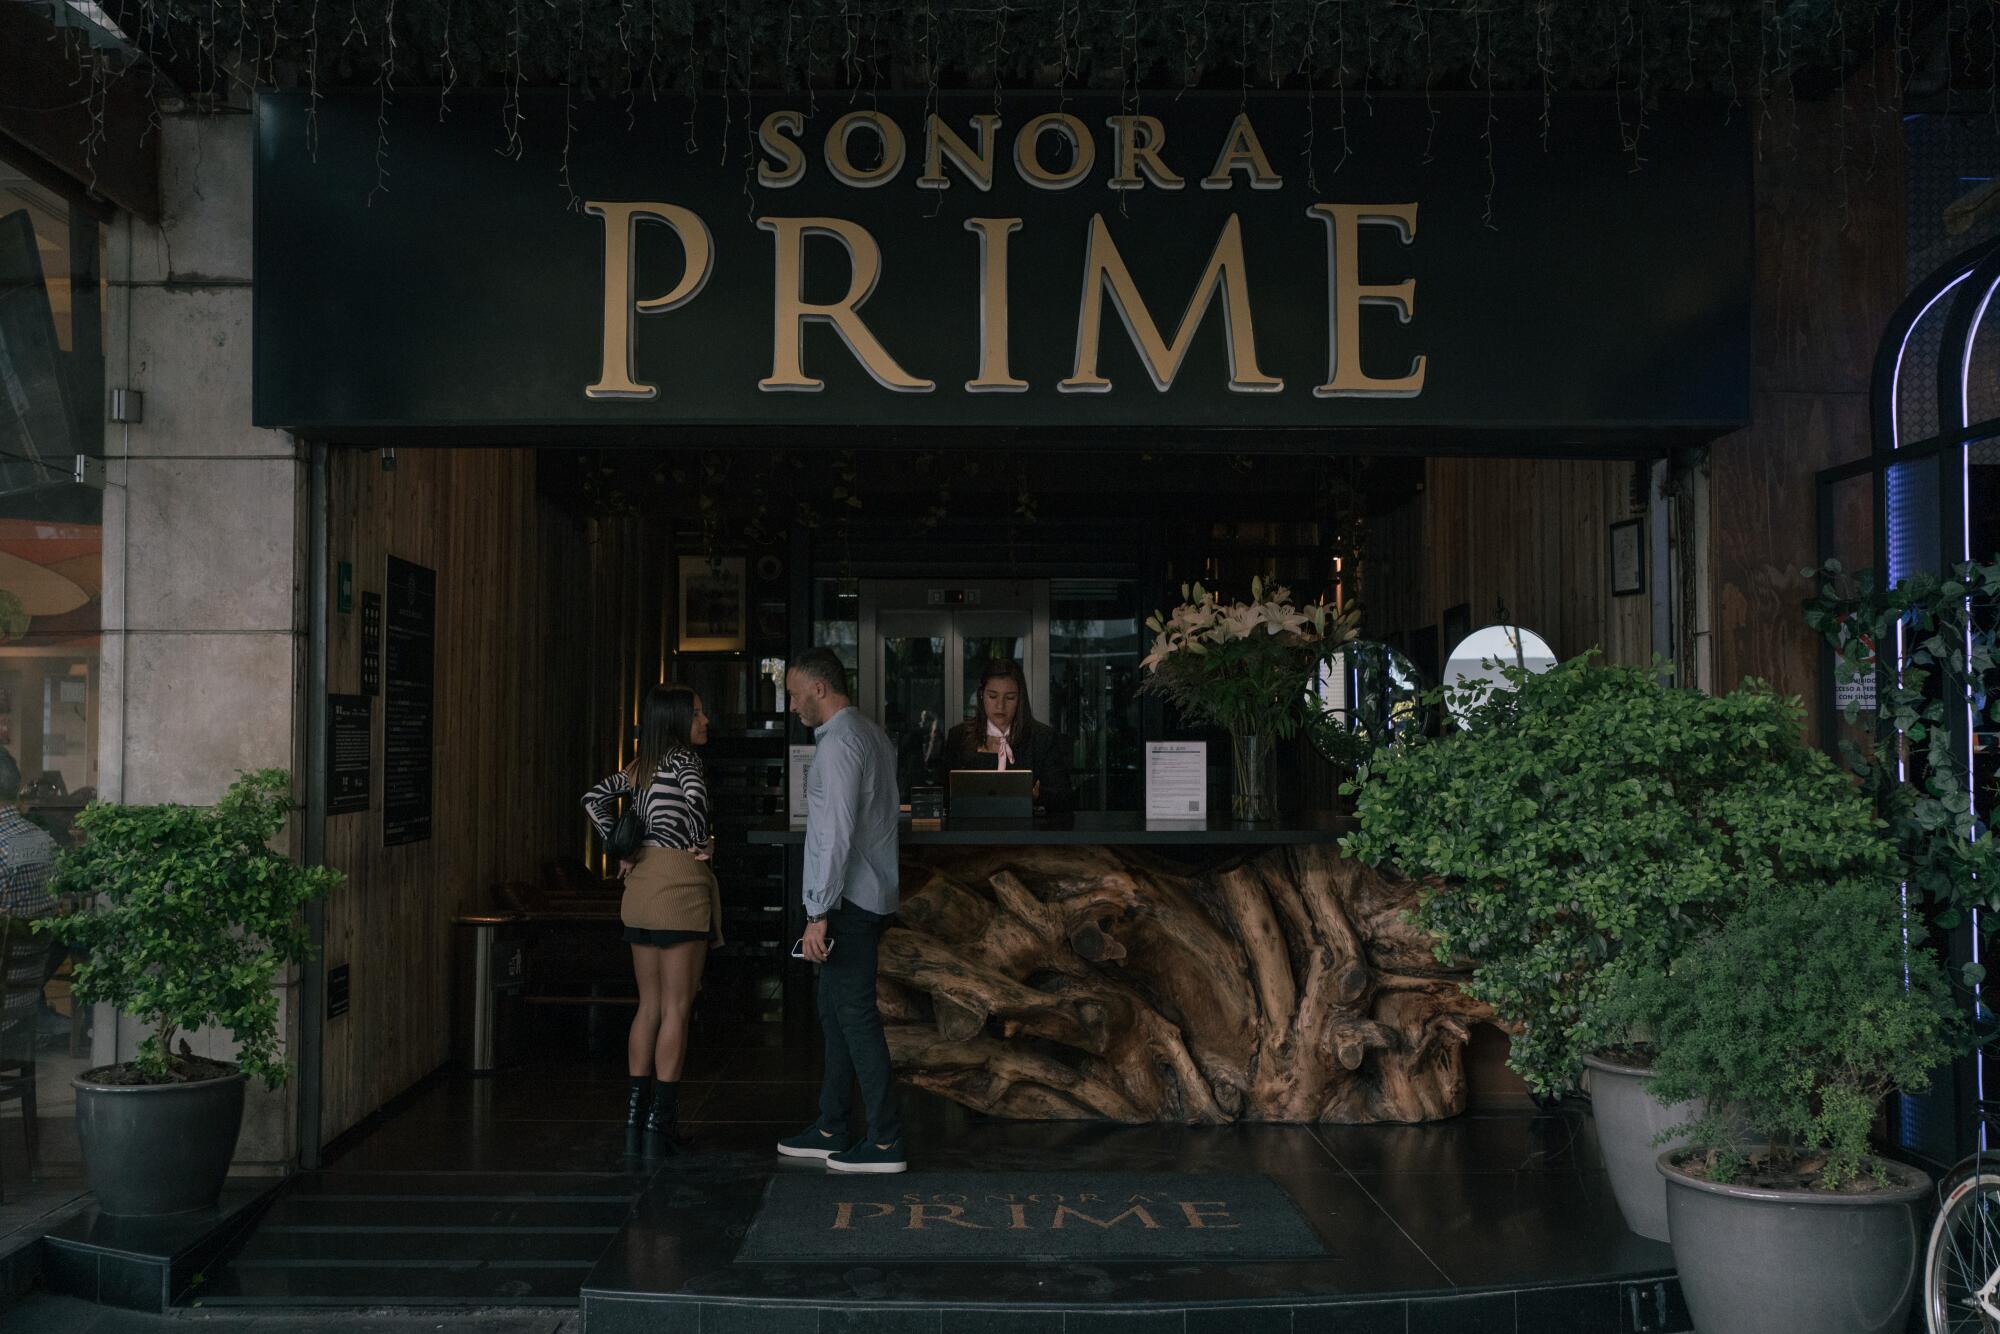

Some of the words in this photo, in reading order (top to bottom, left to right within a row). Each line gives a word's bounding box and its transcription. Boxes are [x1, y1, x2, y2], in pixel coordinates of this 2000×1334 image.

[757, 109, 1285, 193] SONORA
[584, 200, 1428, 400] PRIME
[830, 1200, 1241, 1231] PRIME
[901, 1192, 1154, 1203] SONORA
